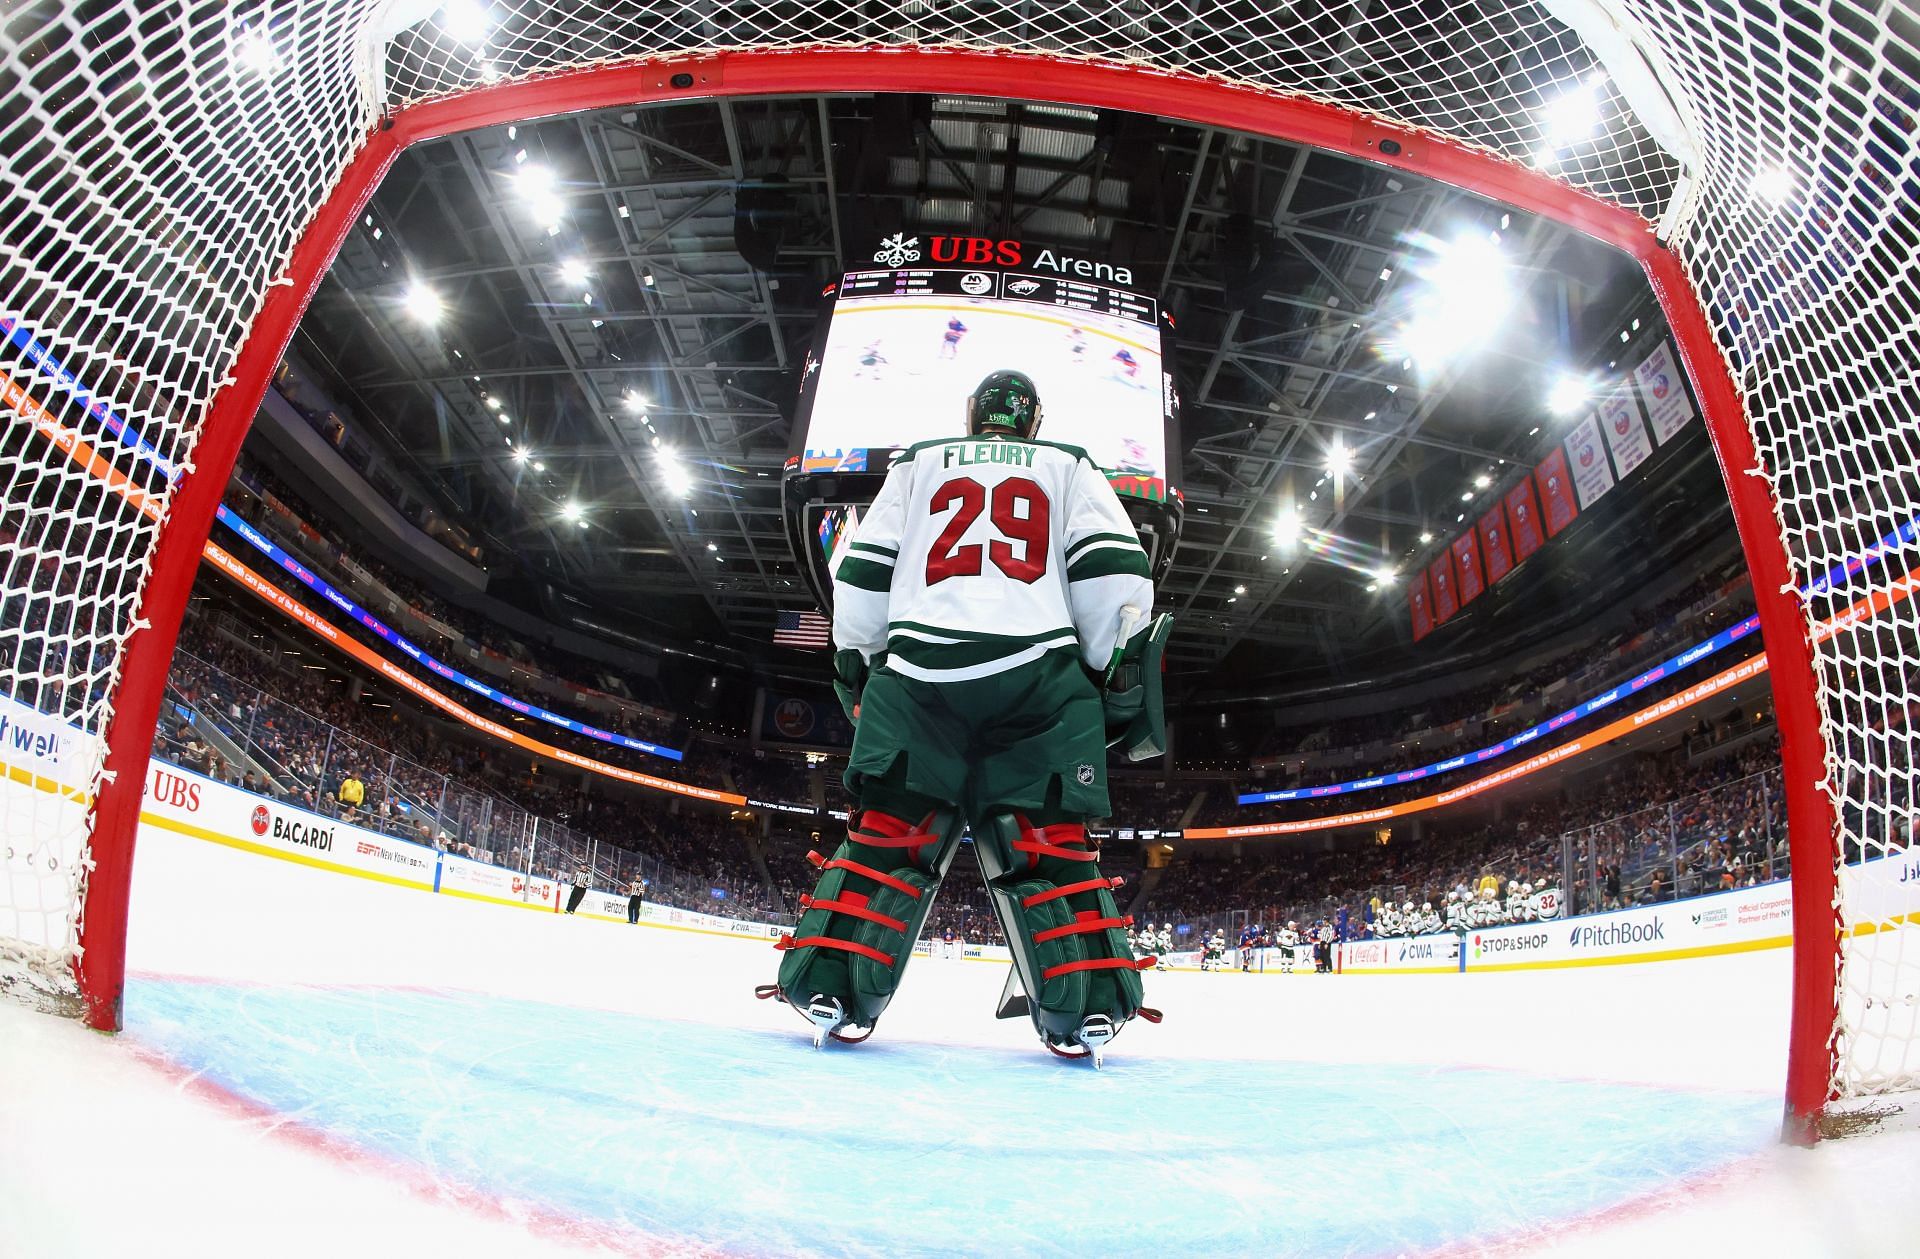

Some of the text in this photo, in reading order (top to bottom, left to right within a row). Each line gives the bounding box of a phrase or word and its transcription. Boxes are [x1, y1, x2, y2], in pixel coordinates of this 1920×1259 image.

[930, 237, 1133, 285] UBS Arena
[944, 443, 1037, 469] FLEURY
[926, 476, 1050, 587] 29
[1753, 656, 1767, 673] part
[153, 769, 201, 812] UBS
[748, 799, 815, 815] NEW YORK ISLANDERS
[273, 816, 336, 852] BACARDÍ
[356, 841, 382, 858] ESPN
[603, 899, 626, 915] verizon
[1541, 894, 1555, 910] 32
[1738, 898, 1792, 914] Official Corporate
[1738, 909, 1791, 925] Partner of the NY
[736, 923, 750, 933] CWA
[1584, 915, 1665, 948] PitchBook
[1409, 943, 1433, 959] CWA
